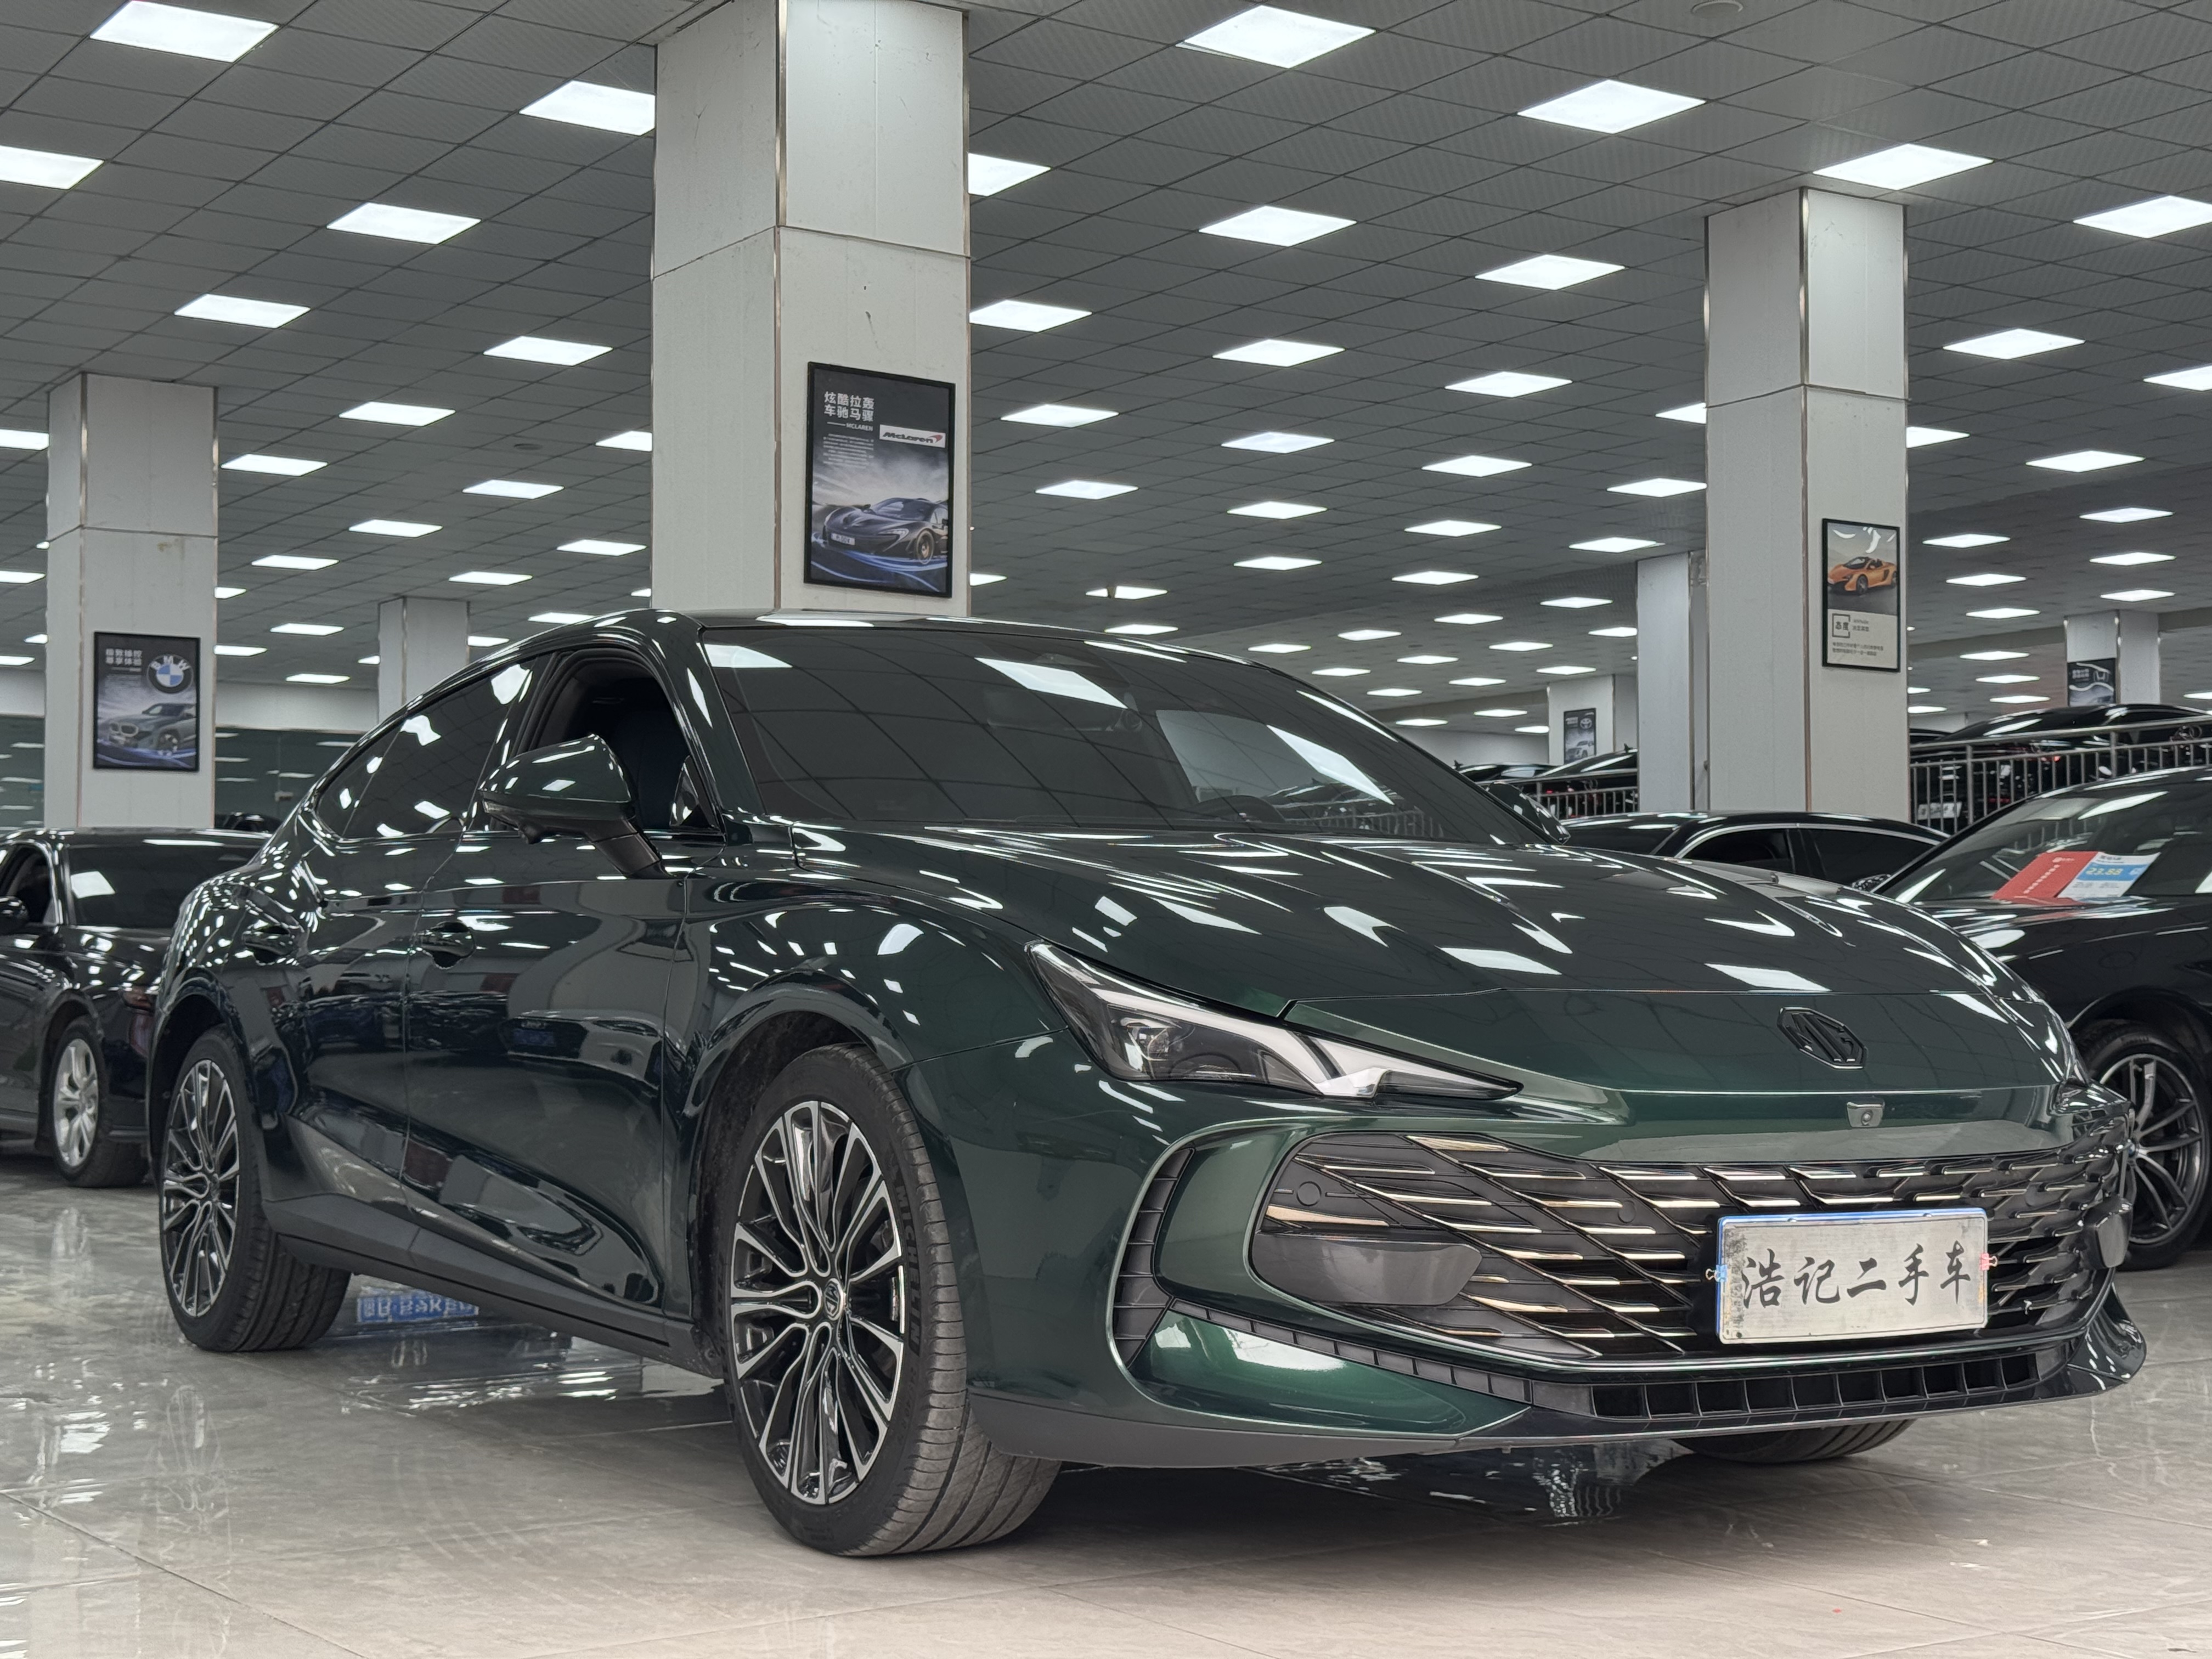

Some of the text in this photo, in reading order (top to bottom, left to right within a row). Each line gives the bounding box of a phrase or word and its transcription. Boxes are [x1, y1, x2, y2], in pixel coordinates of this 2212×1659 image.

[824, 391, 875, 410] 炫酷拉轰
[150, 656, 191, 671] BMW
[894, 1184, 921, 1350] MICHELIN
[1741, 1240, 1971, 1309] 浩记二手车
